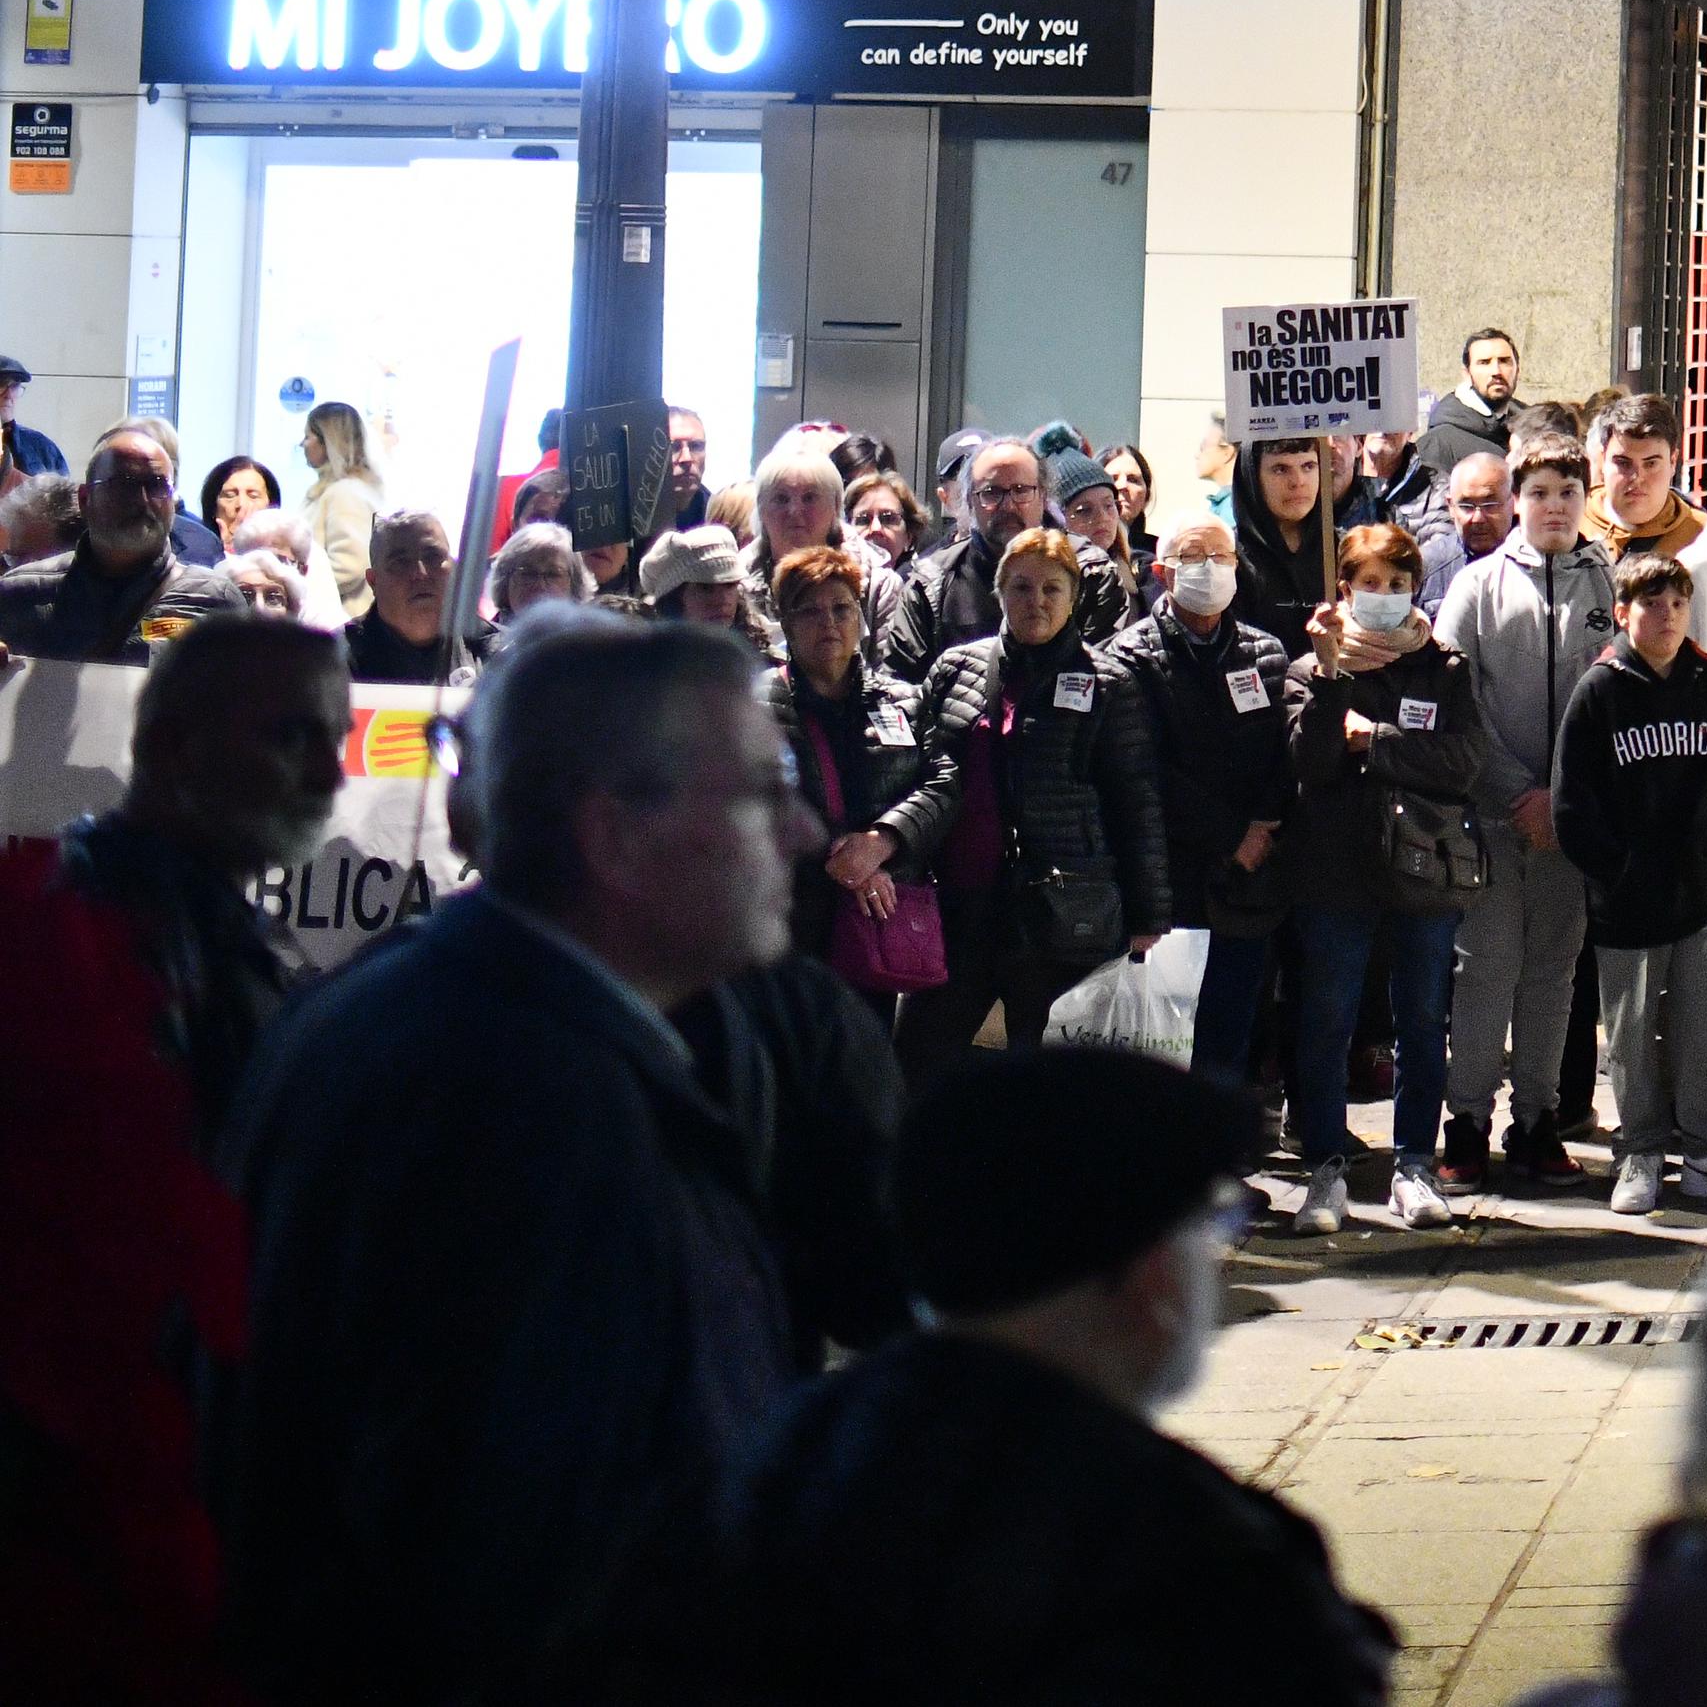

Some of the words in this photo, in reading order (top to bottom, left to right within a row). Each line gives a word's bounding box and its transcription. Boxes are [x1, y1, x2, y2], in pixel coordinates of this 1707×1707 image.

[976, 12, 1030, 42] Only
[1038, 18, 1079, 41] you
[860, 45, 900, 66] can
[909, 41, 983, 66] define
[992, 43, 1088, 71] yourself
[14, 125, 68, 137] segurma
[1101, 162, 1133, 186] 47
[1248, 322, 1272, 347] la
[1276, 303, 1409, 345] SANITAT
[1232, 348, 1262, 371] no
[1267, 343, 1296, 370] és
[1300, 345, 1331, 368] un
[1250, 356, 1381, 410] NEGOCI!
[584, 422, 600, 448] LA
[574, 453, 620, 491] SALUD
